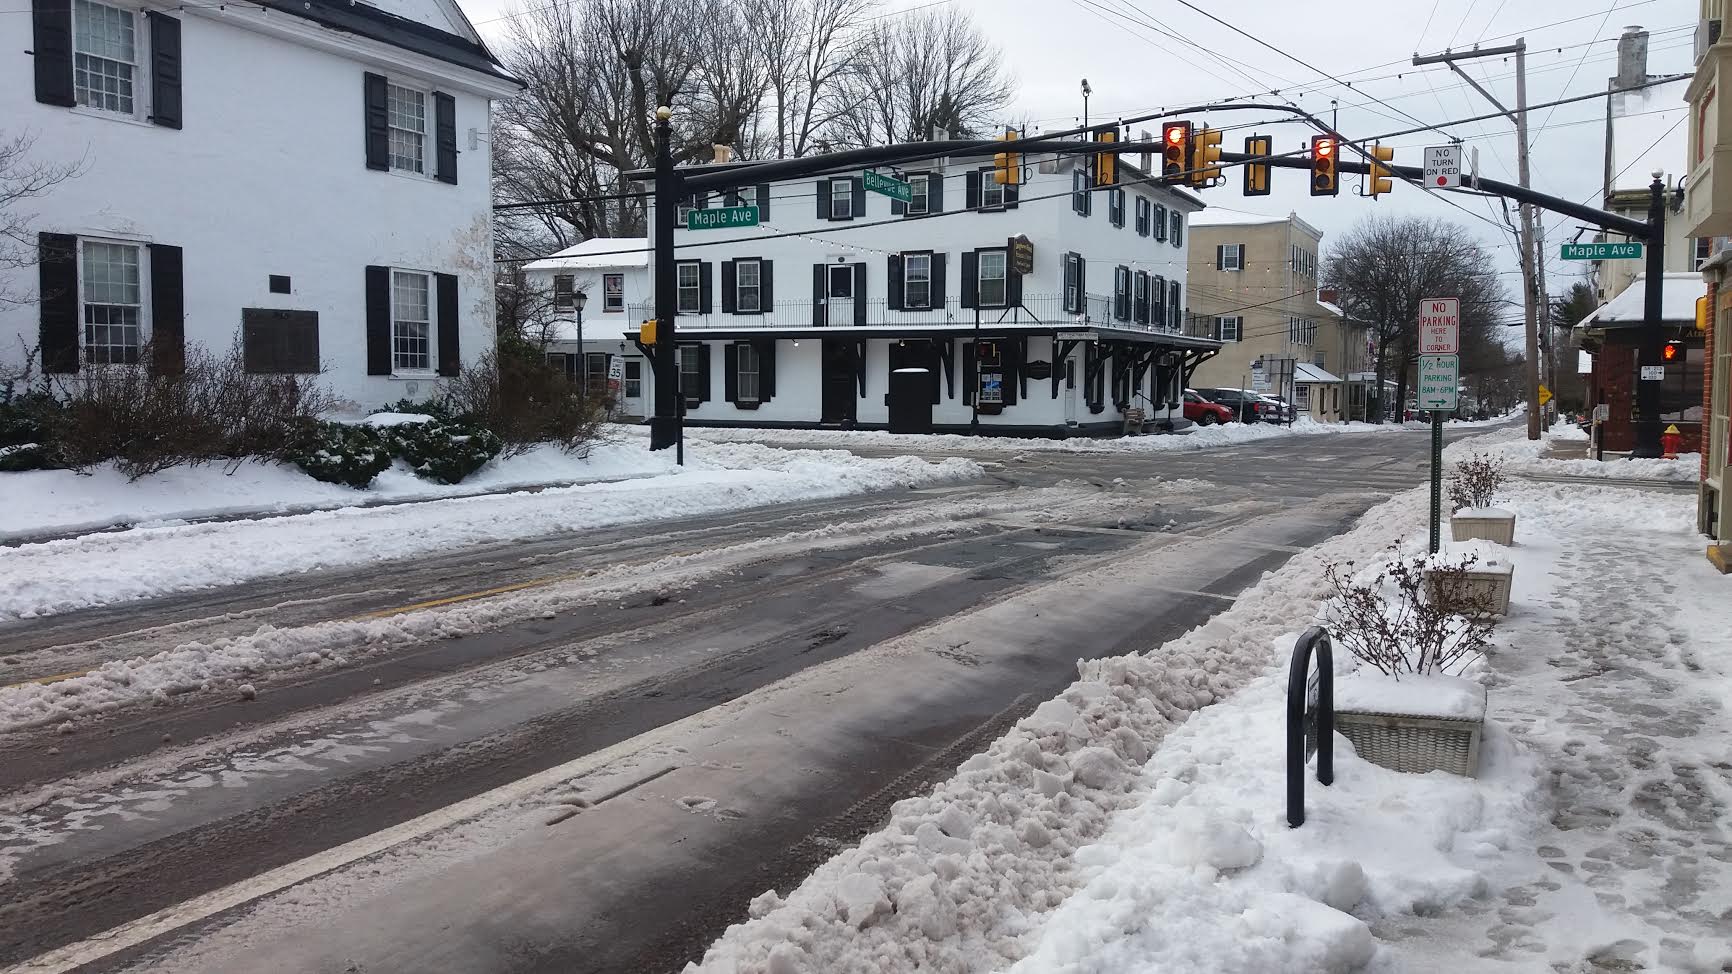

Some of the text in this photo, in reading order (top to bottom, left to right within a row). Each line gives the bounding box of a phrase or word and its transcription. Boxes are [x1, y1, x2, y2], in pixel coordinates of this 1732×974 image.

[1435, 149, 1450, 157] NO
[1426, 167, 1459, 176] ON RED
[694, 210, 752, 227] Maple Ave
[1568, 245, 1635, 258] Maple Ave
[1432, 302, 1447, 313] NO
[1422, 315, 1456, 326] PARKING
[610, 368, 622, 378] 35
